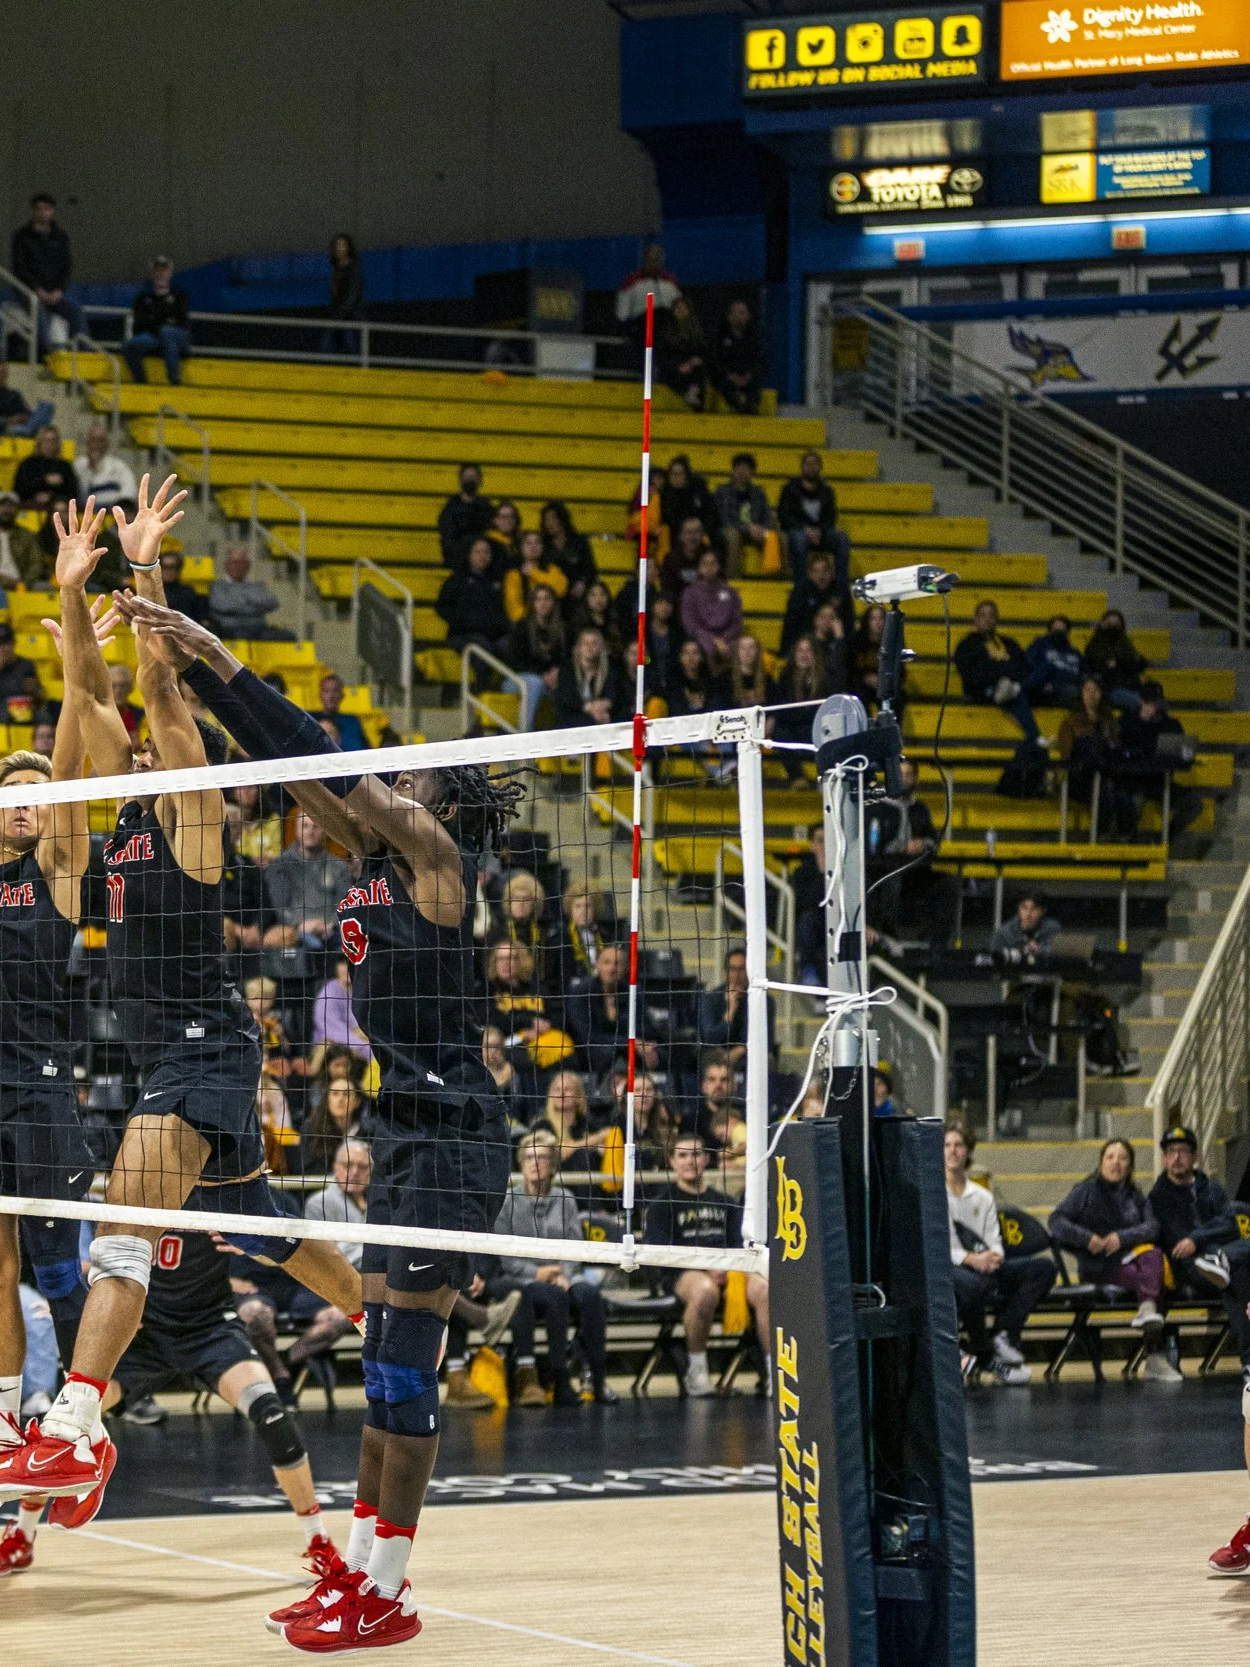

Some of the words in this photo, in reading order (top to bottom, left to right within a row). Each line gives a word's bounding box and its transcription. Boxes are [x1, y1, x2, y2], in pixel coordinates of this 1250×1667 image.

[1083, 7, 1143, 27] Dignity
[1098, 29, 1123, 40] Mary
[1125, 27, 1162, 37] Medical
[1164, 24, 1196, 34] Center
[1043, 60, 1073, 71] Health
[1074, 58, 1107, 69] Partner
[1108, 57, 1119, 66] of
[1120, 55, 1143, 67] Long
[1145, 53, 1172, 64] Beach
[1175, 51, 1198, 62] State
[1201, 49, 1239, 60] Athletics
[748, 70, 816, 89] FOLLOW
[817, 68, 840, 85] US
[841, 66, 866, 84] ON
[867, 63, 924, 82] SOCIAL
[925, 59, 978, 78] MEDIA
[870, 183, 944, 204] TOYOTA
[106, 872, 125, 924] 11
[775, 1326, 803, 1548] STATE
[783, 1562, 808, 1667] CH
